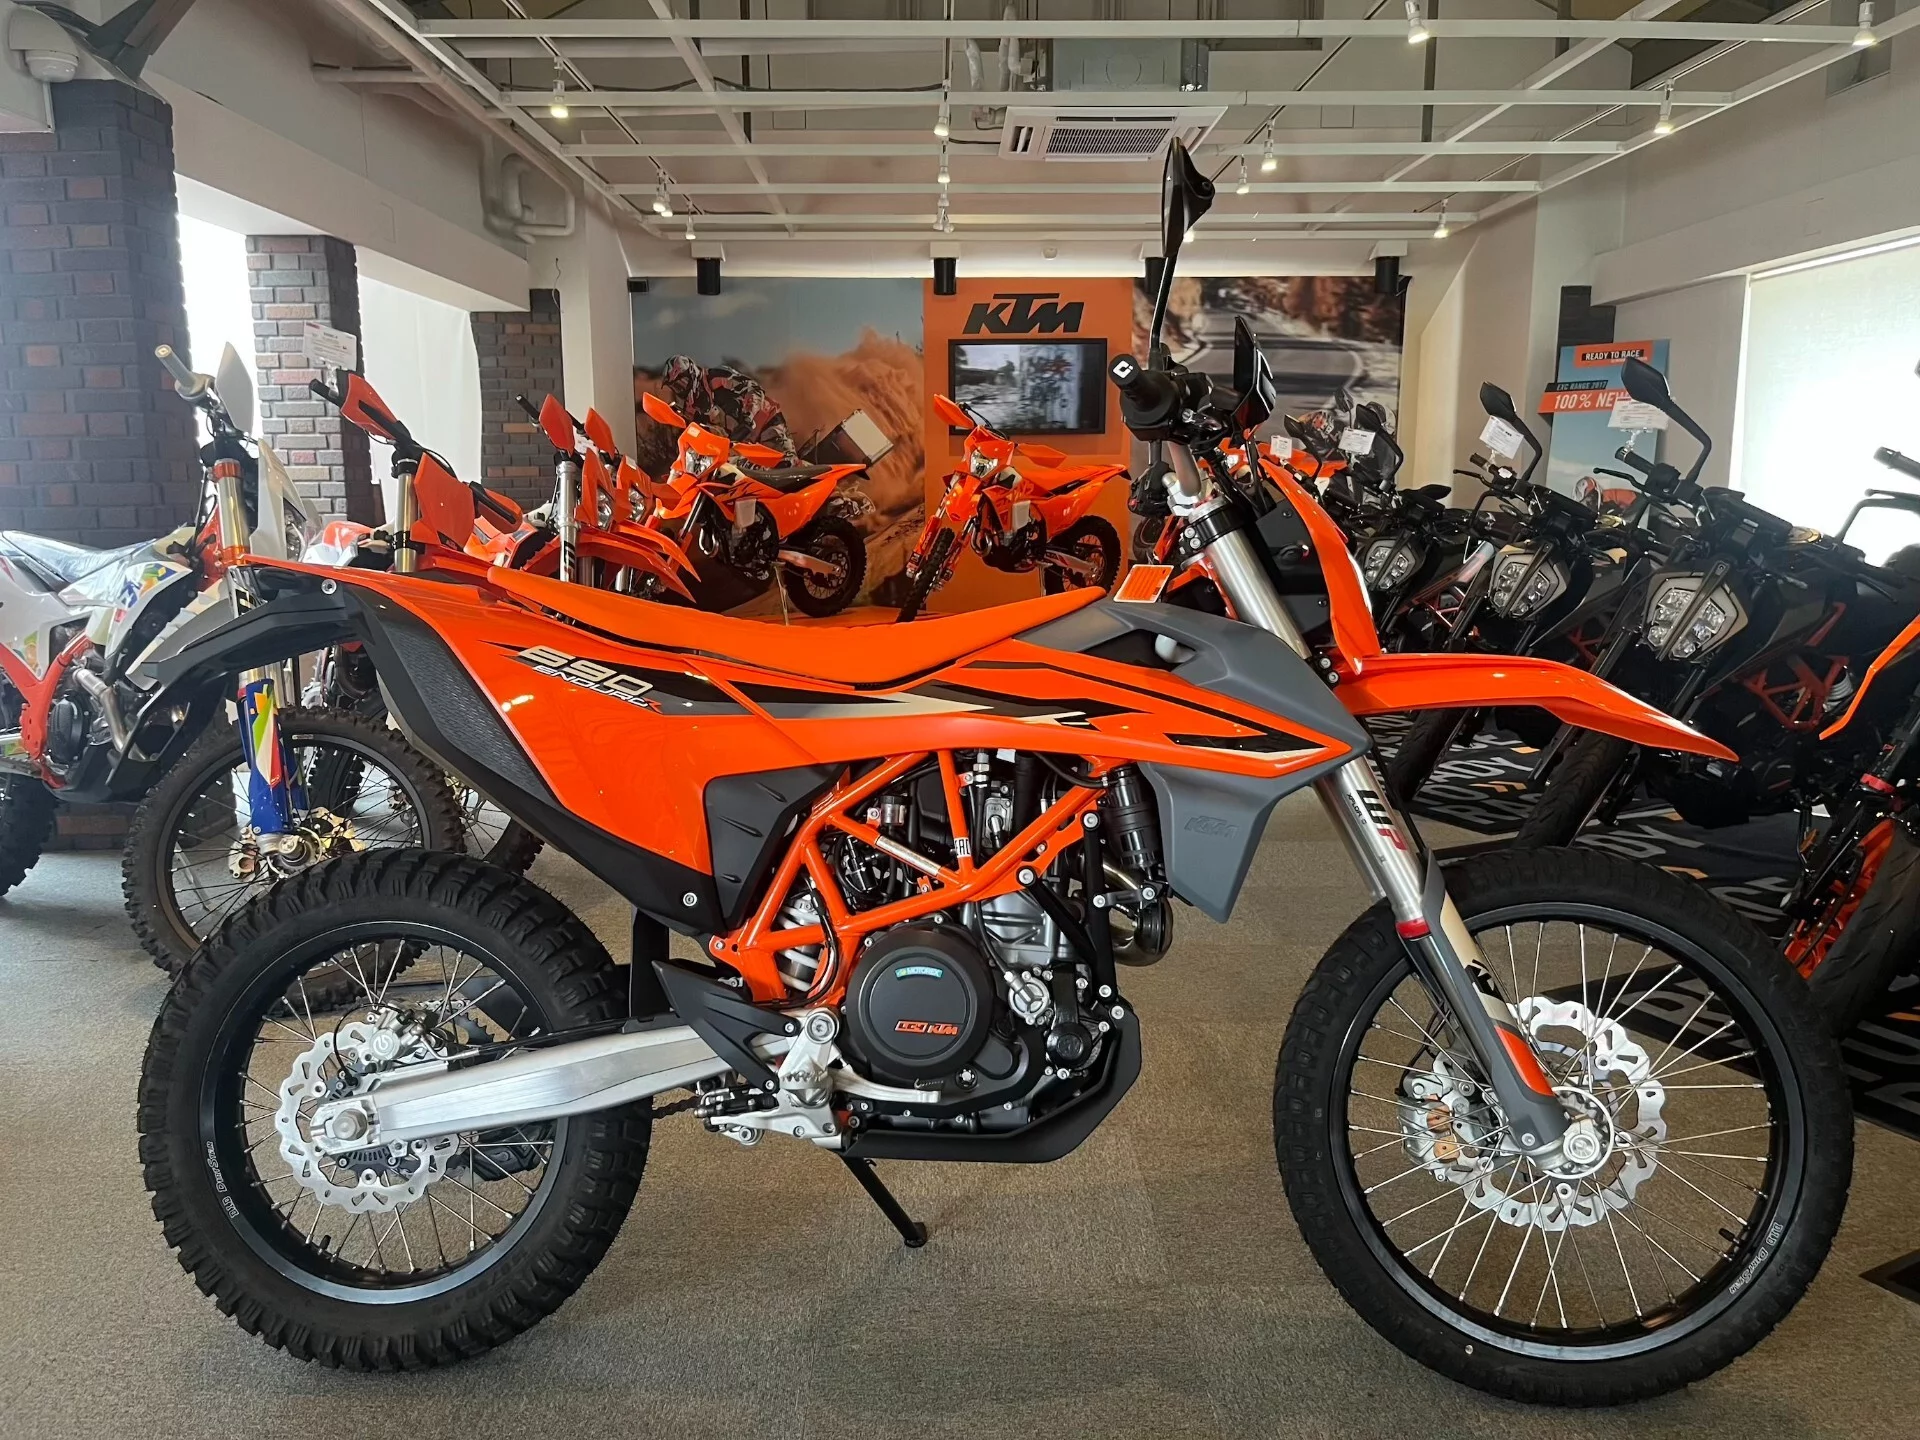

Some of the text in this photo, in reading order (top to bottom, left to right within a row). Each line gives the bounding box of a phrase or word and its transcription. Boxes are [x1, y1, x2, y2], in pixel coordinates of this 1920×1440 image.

[962, 293, 1084, 334] KTM
[1585, 352, 1608, 361] READY
[1611, 351, 1620, 359] TO
[1621, 349, 1640, 358] RACE
[1556, 383, 1568, 391] EXC
[1569, 382, 1590, 390] RANGE
[517, 644, 654, 696] 690
[1184, 815, 1241, 838] KTM
[927, 1023, 958, 1035] KTM
